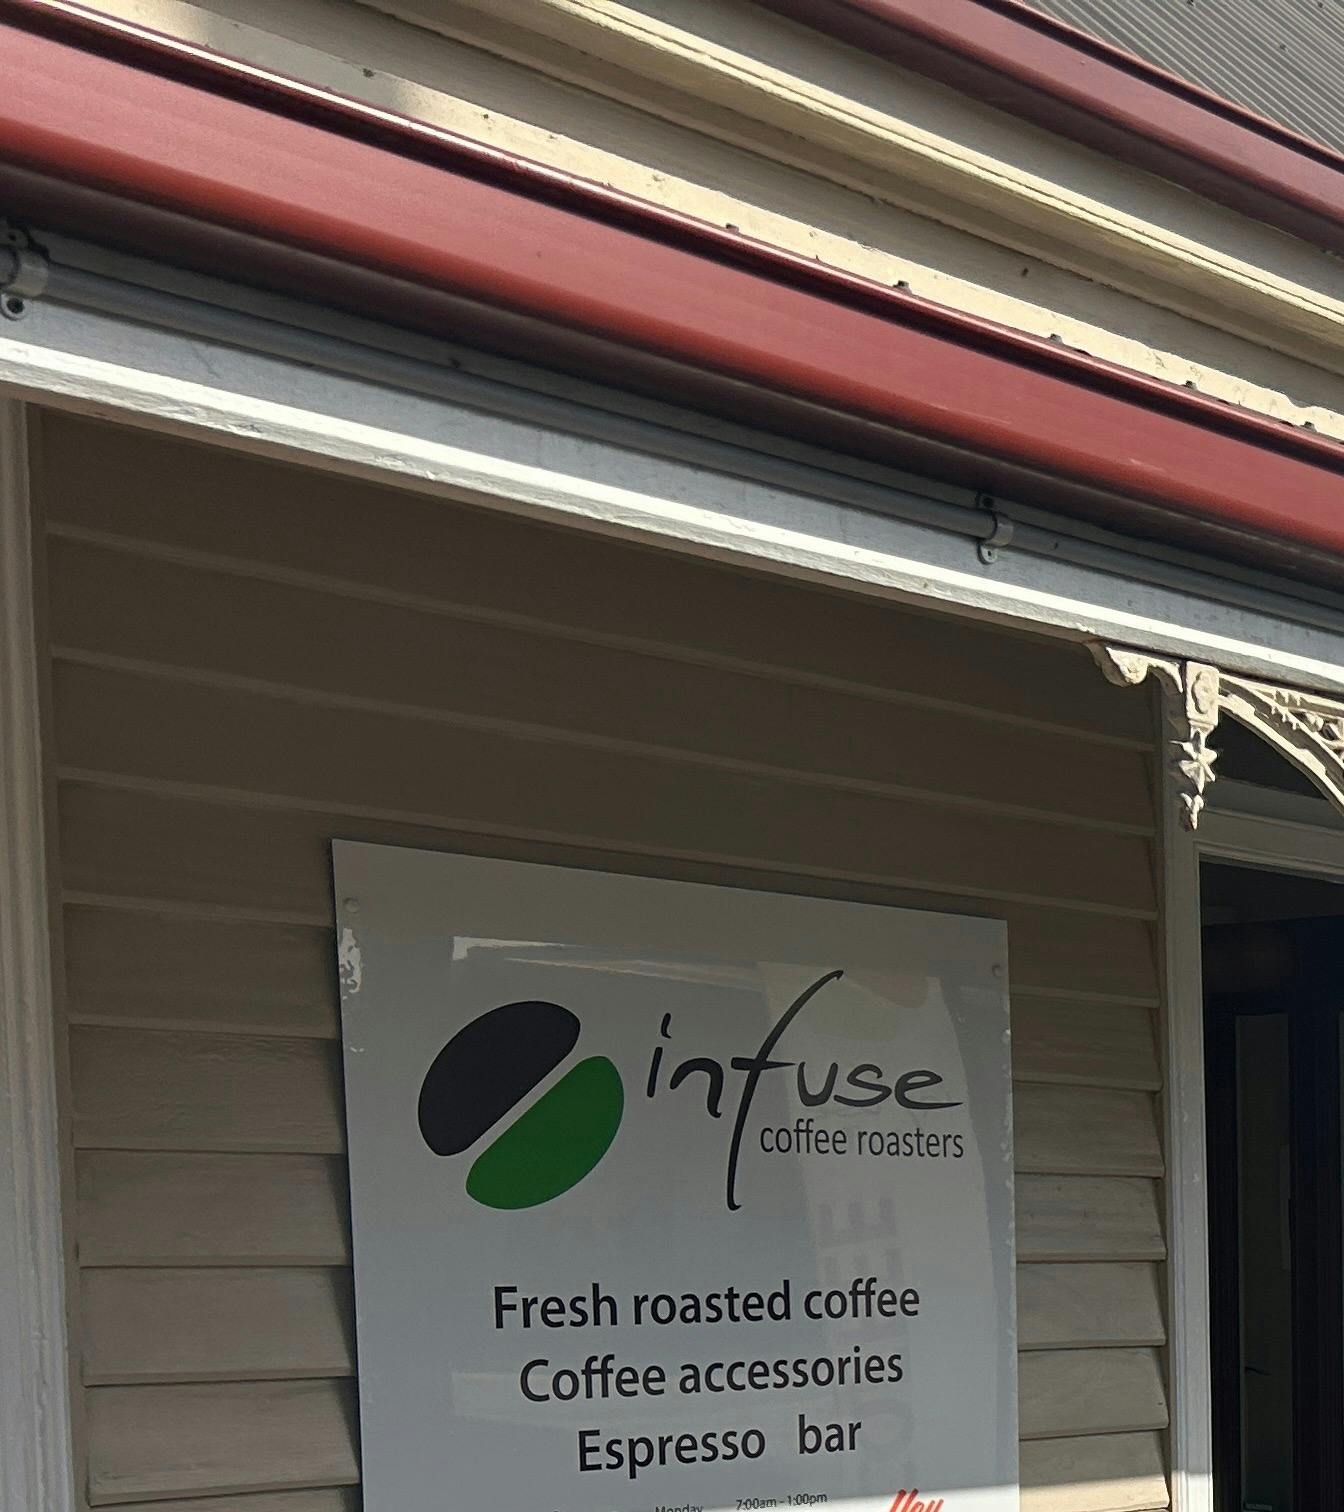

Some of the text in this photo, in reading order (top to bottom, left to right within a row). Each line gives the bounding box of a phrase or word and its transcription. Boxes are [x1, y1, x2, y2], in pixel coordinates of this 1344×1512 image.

[646, 969, 964, 1211] infuse
[760, 1119, 964, 1159] coffee roasters
[494, 1276, 920, 1329] Fresh roasted coffee
[520, 1346, 903, 1402] Coffee accessories
[578, 1414, 862, 1479] Espresso bar
[736, 1498, 777, 1511] 7:00am
[788, 1493, 828, 1508] 1:00pm
